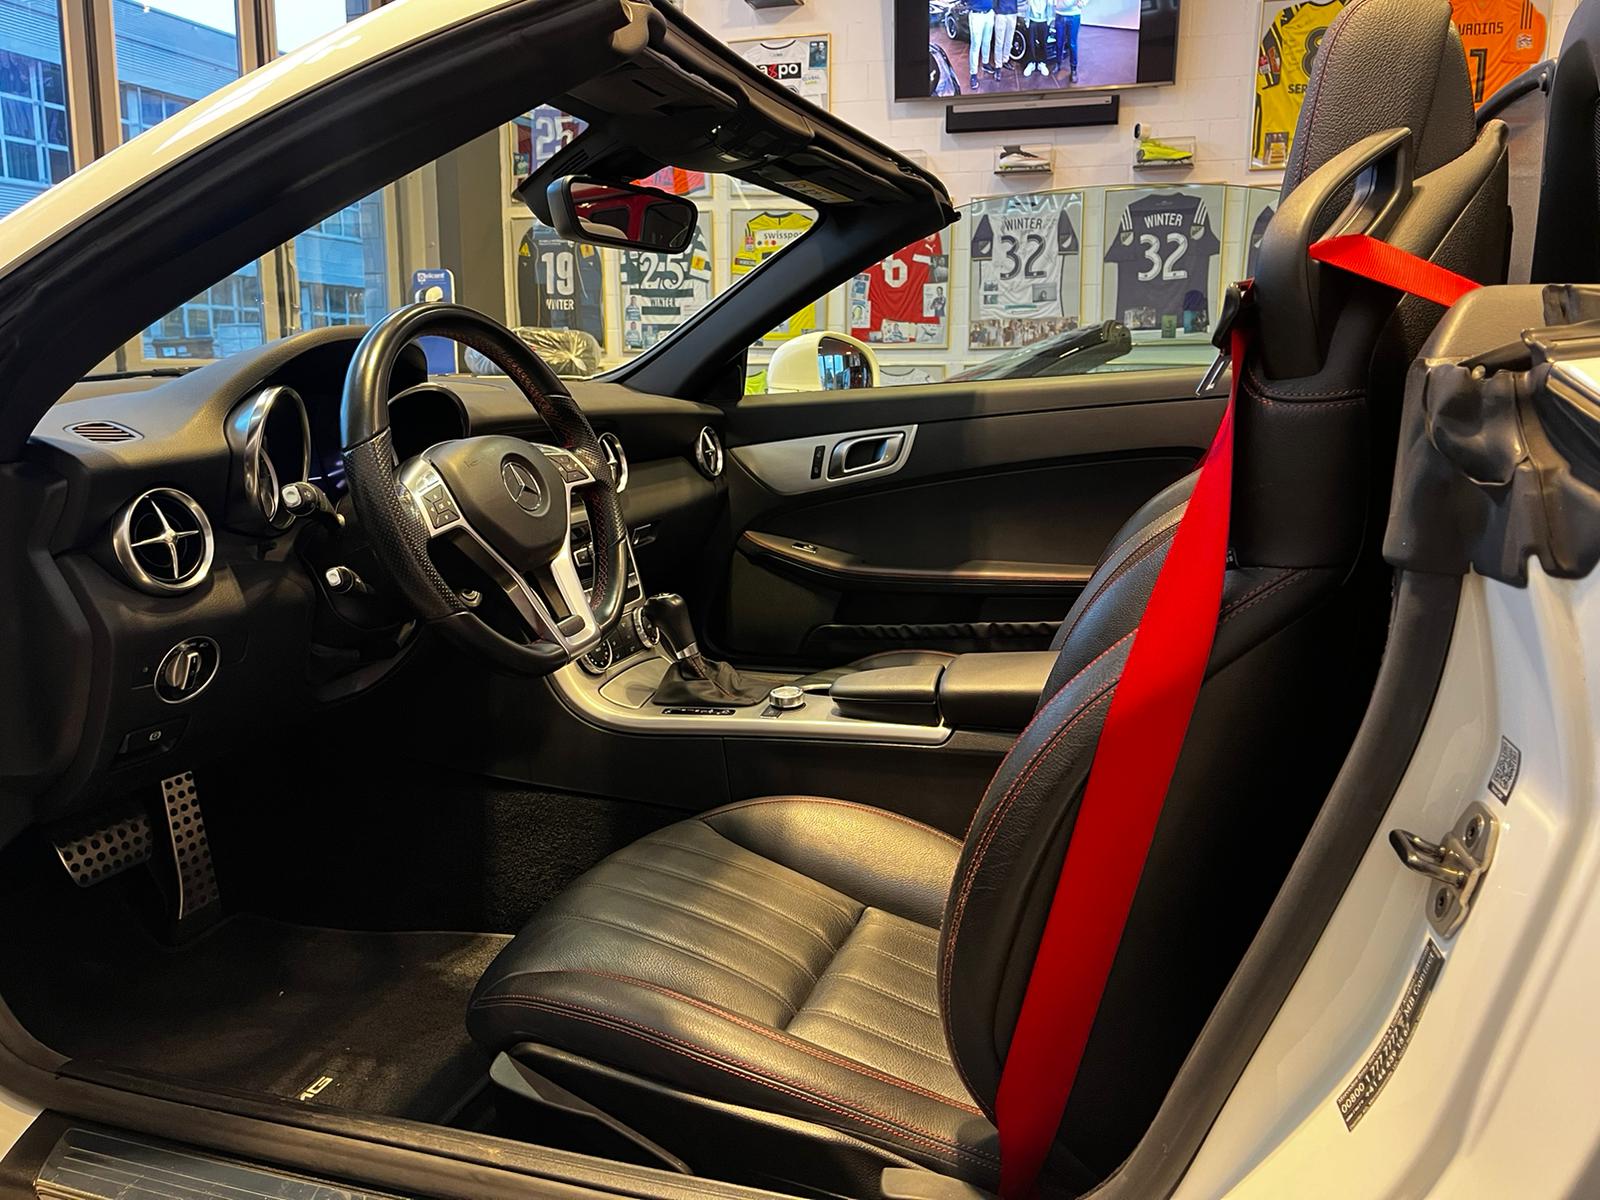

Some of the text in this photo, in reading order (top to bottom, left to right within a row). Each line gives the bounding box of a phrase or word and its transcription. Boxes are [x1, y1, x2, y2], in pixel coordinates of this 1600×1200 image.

[1004, 217, 1043, 231] WINTER
[1144, 213, 1183, 229] WINTER
[541, 252, 574, 295] 19
[639, 252, 685, 290] 25
[1000, 234, 1047, 280] 32
[1138, 233, 1188, 281] 32
[545, 299, 575, 311] WINTER
[1341, 1083, 1365, 1113] 00800
